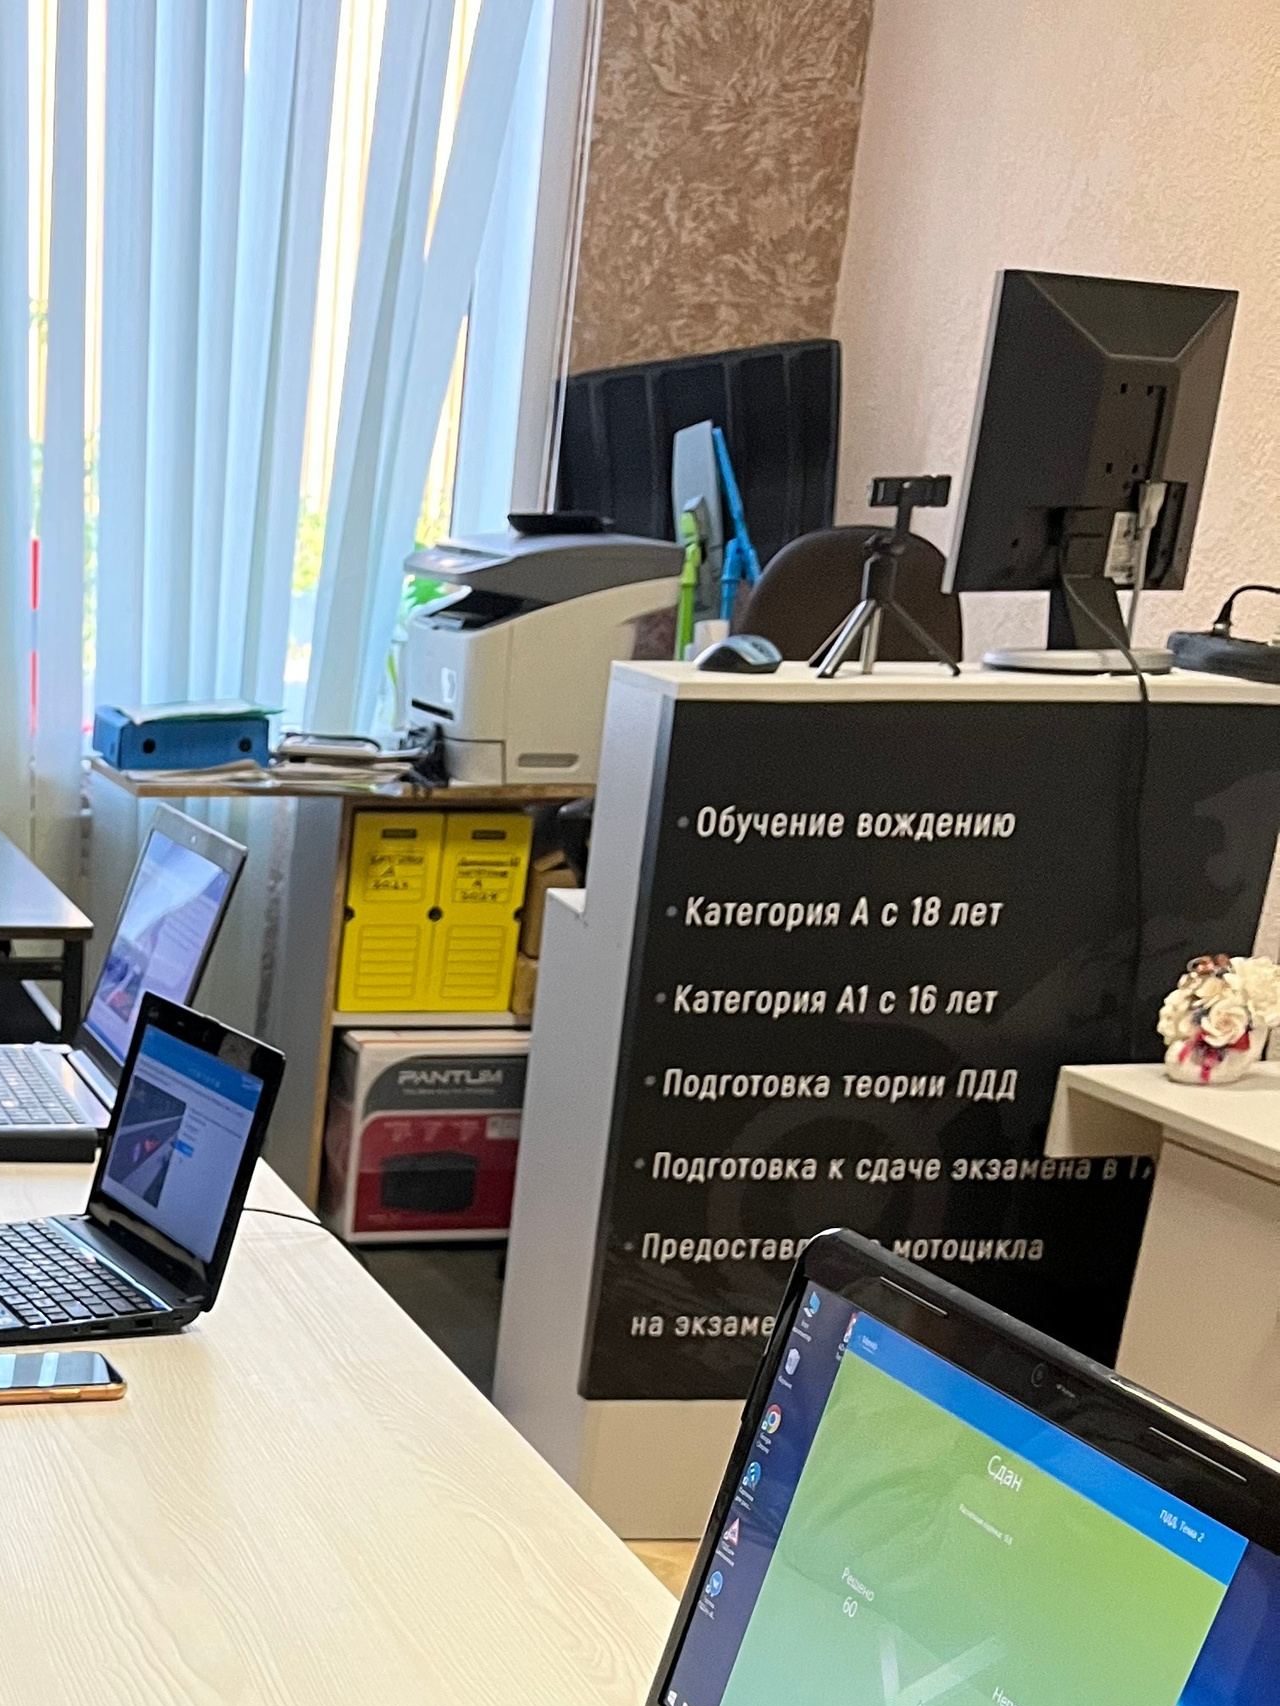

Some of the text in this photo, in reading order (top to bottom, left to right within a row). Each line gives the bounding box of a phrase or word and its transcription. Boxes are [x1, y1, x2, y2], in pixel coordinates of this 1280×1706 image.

[696, 806, 1017, 842] Обучение вождению
[684, 896, 1004, 932] Категория А с 18 лет
[673, 984, 999, 1019] Категория А1 с 16 лет
[662, 1068, 1019, 1102] Подготовка теории ПДД
[651, 1151, 818, 1183] Подготовка
[827, 1157, 845, 1181] к
[854, 1157, 942, 1184] сдаче
[950, 1157, 1092, 1182] экзамена
[890, 1239, 1044, 1264] мотоцикла
[630, 1315, 664, 1338] на
[674, 1314, 776, 1338] экзаме
[987, 1454, 1023, 1493] Сдан
[841, 1567, 875, 1602] Решено
[842, 1596, 858, 1618] 60
